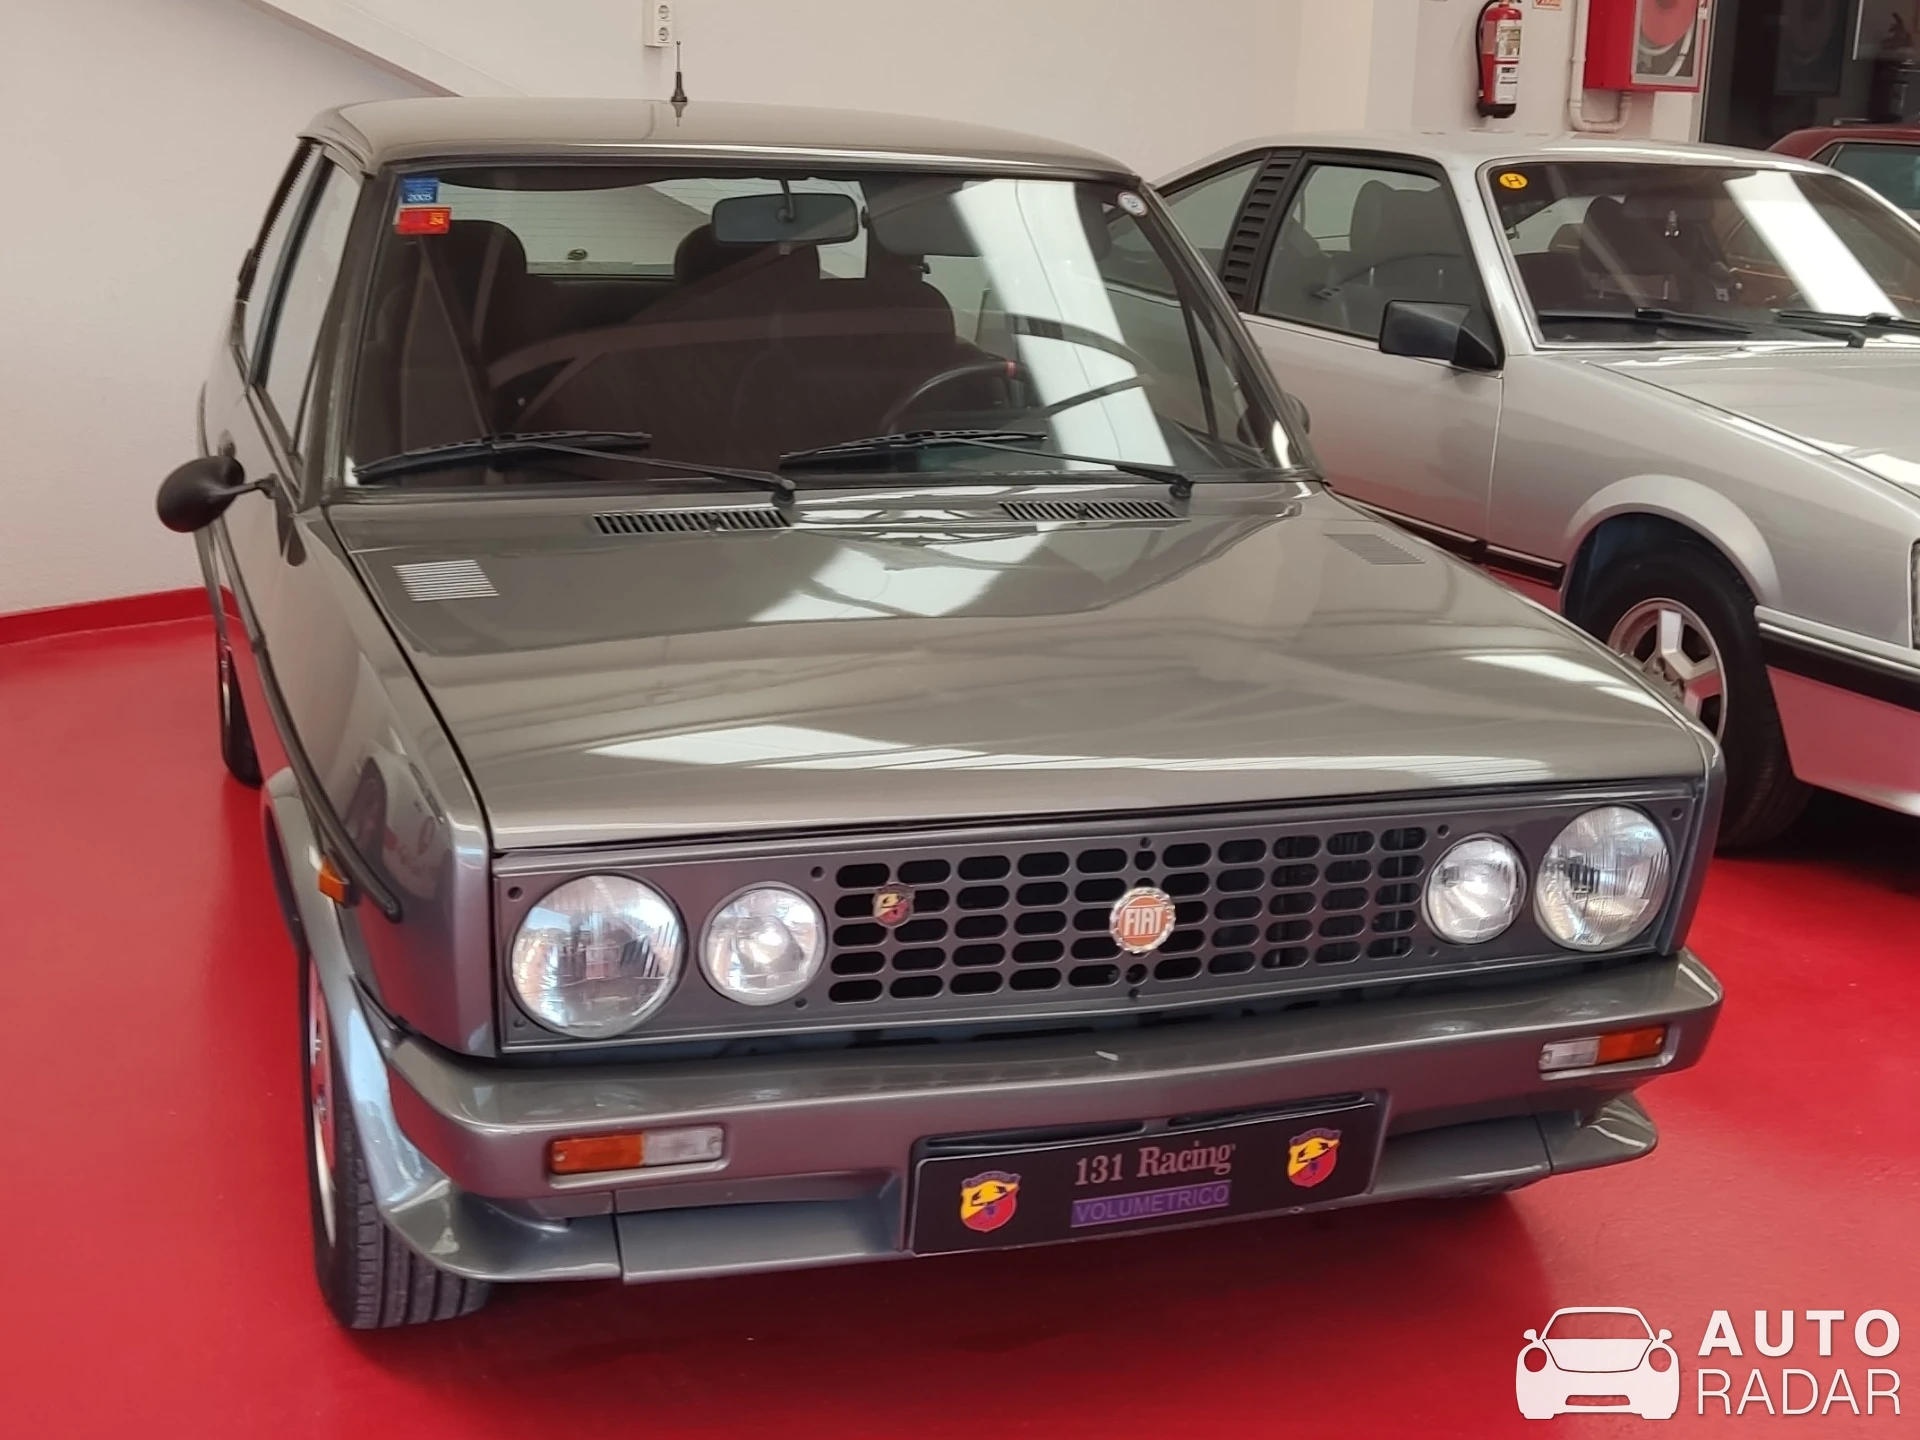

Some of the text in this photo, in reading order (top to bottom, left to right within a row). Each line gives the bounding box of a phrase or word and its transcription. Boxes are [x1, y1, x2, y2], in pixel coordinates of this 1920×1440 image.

[1123, 905, 1164, 937] FIAT
[1075, 1140, 1236, 1185] 131 Racing
[1074, 1184, 1230, 1222] VOLUMETRICO
